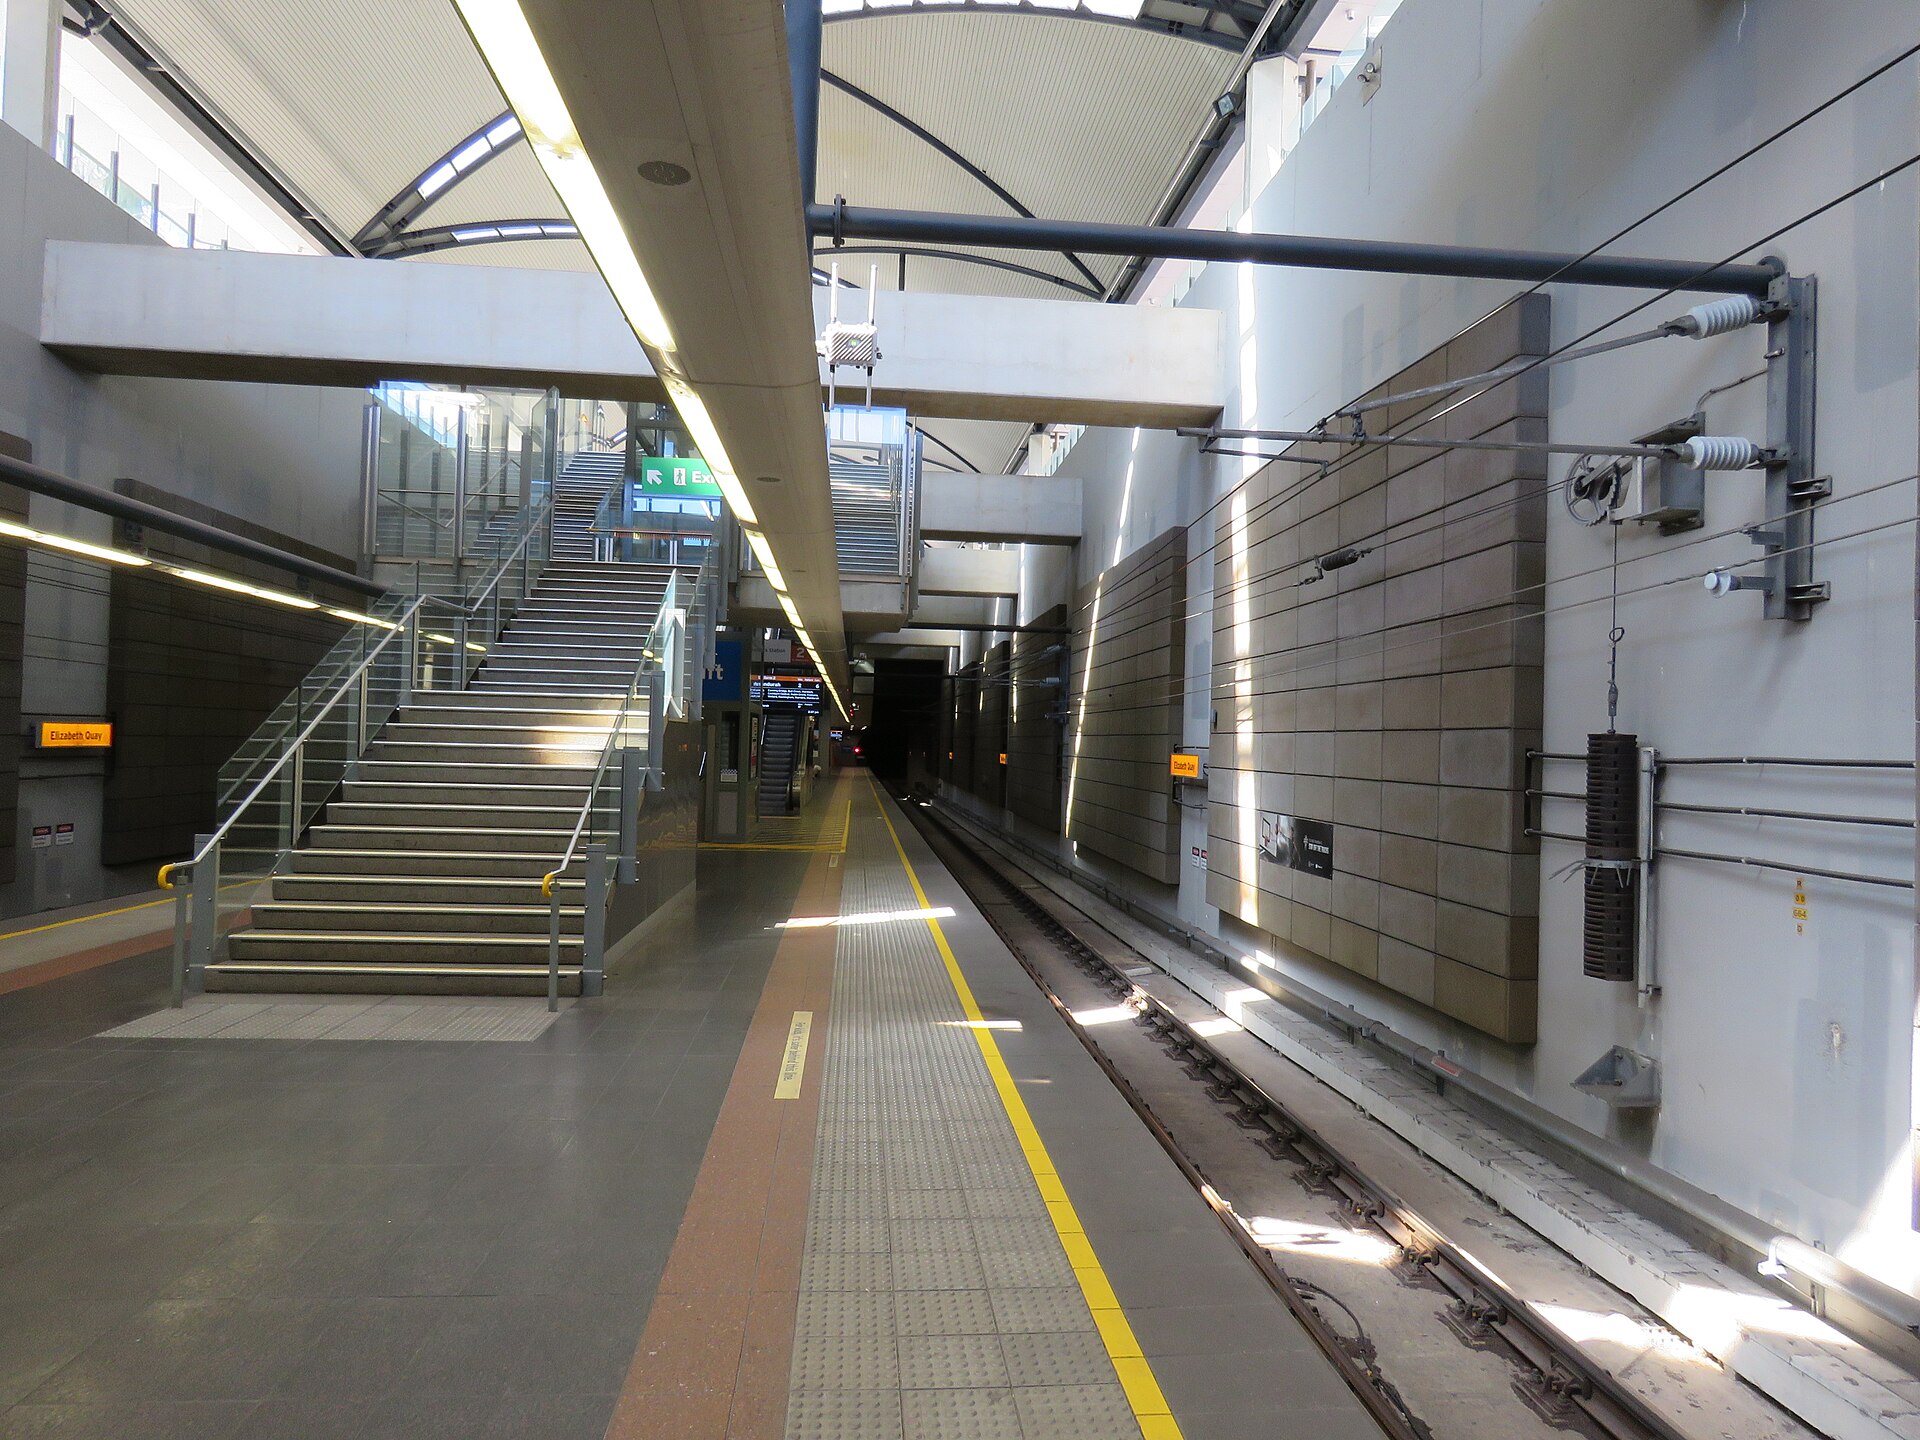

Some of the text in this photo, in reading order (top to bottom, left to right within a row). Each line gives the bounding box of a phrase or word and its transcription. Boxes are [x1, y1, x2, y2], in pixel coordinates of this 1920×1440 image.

[692, 470, 714, 483] Exi
[796, 647, 805, 659] 2
[50, 730, 103, 742] Elizabeth Quay
